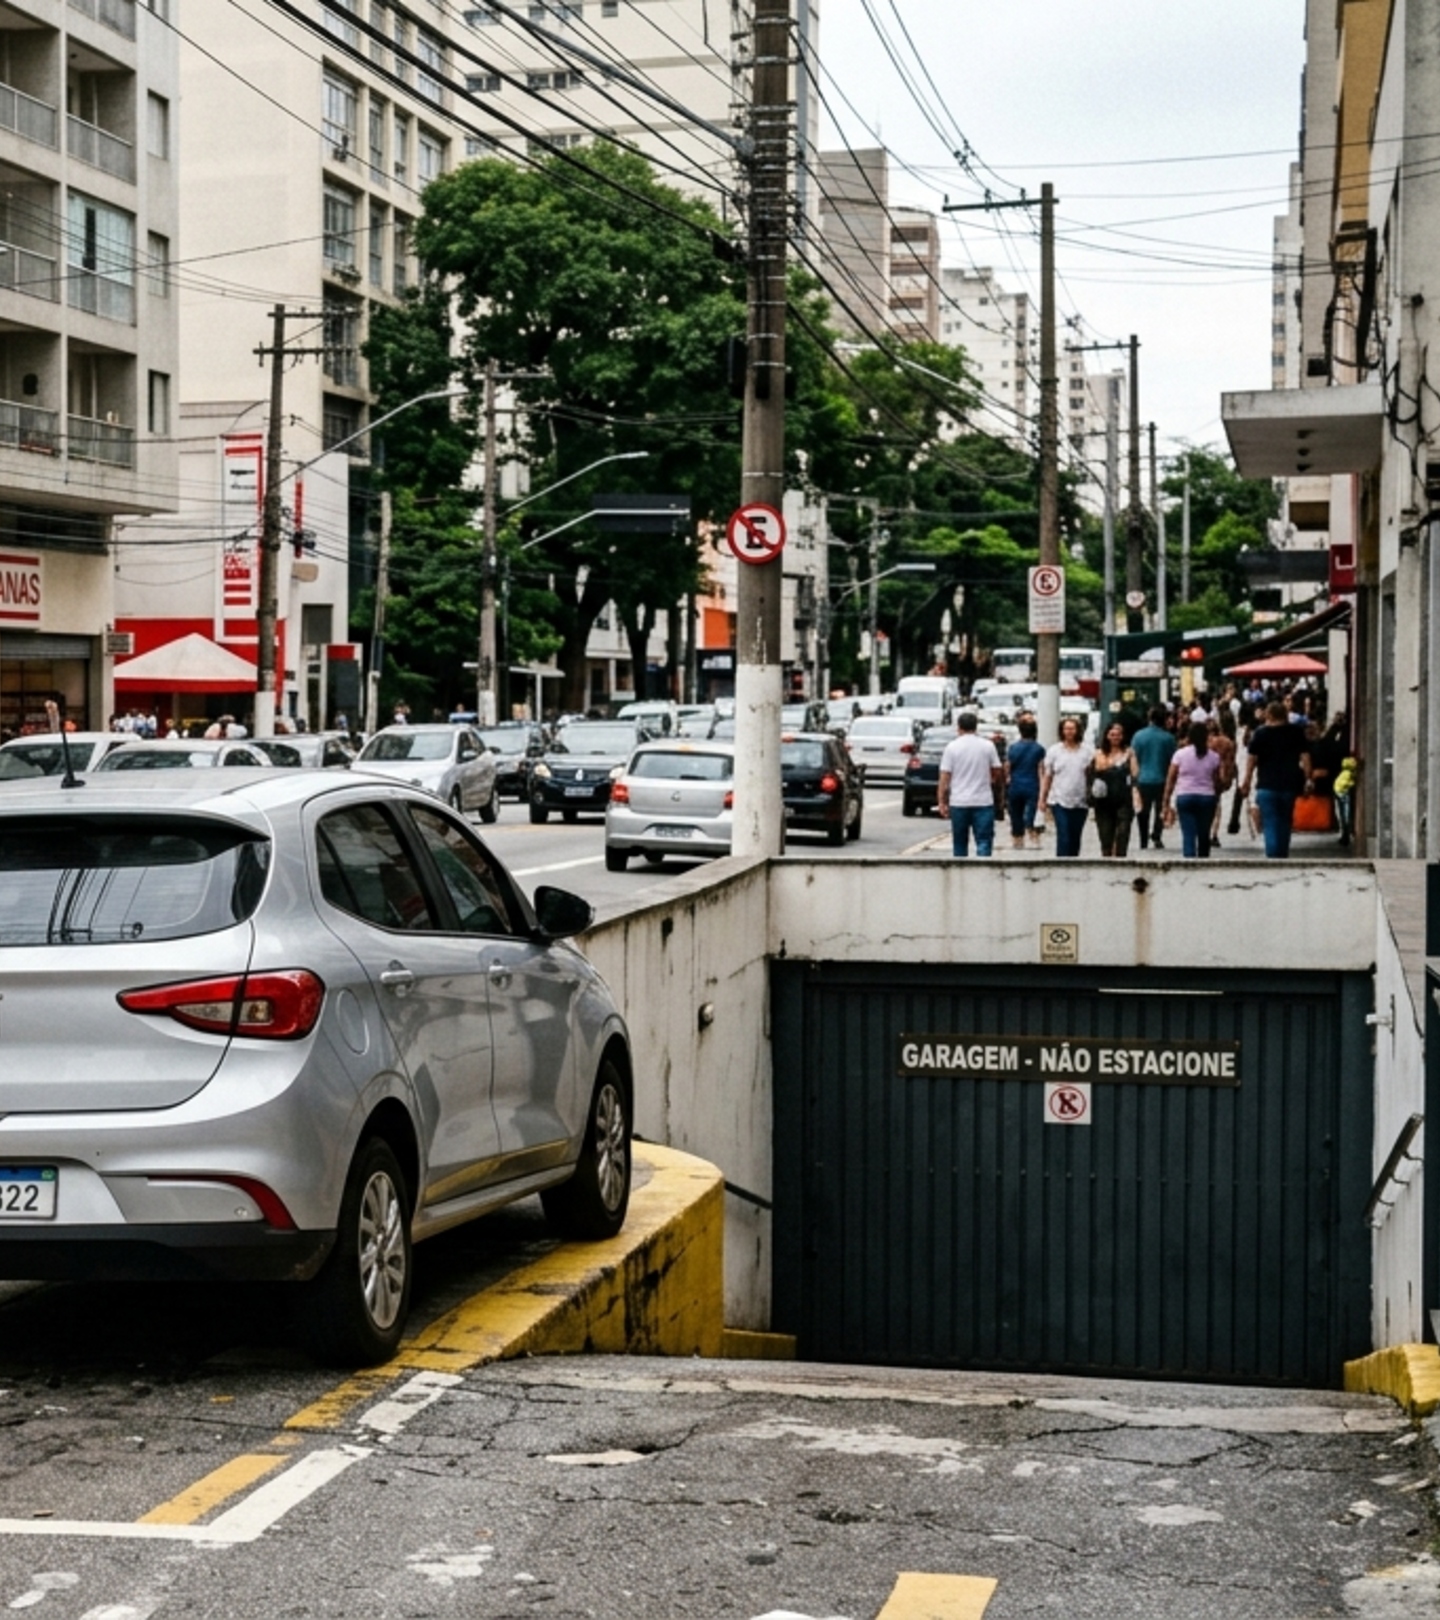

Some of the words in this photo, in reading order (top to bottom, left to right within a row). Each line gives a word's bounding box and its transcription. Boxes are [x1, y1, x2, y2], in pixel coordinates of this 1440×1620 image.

[902, 1043, 1019, 1071] GARAGEM
[1040, 1041, 1091, 1072] NÃO
[1098, 1048, 1235, 1077] ESTACIONE
